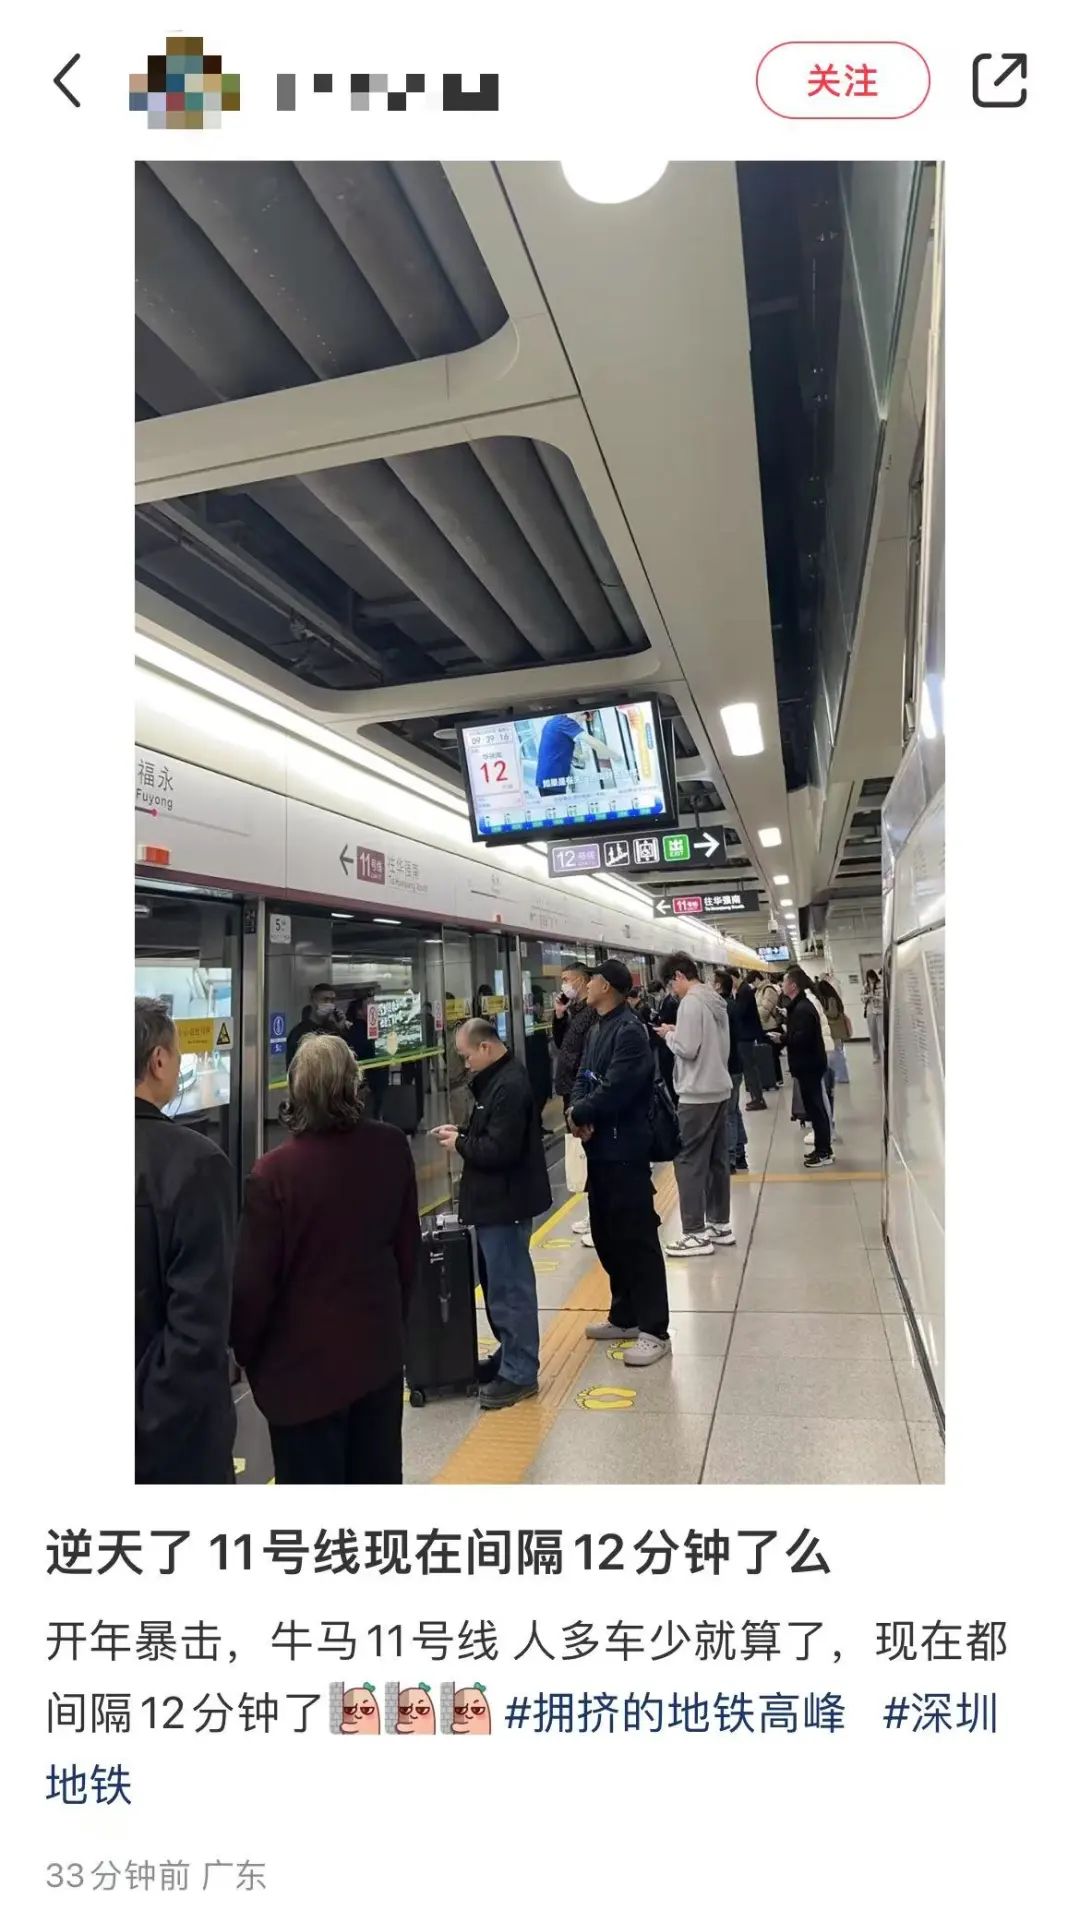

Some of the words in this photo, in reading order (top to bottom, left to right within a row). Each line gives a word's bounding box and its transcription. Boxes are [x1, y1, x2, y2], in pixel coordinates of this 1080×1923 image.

[137, 759, 173, 791] 福永
[480, 760, 508, 783] 12
[135, 788, 173, 811] Fuyong
